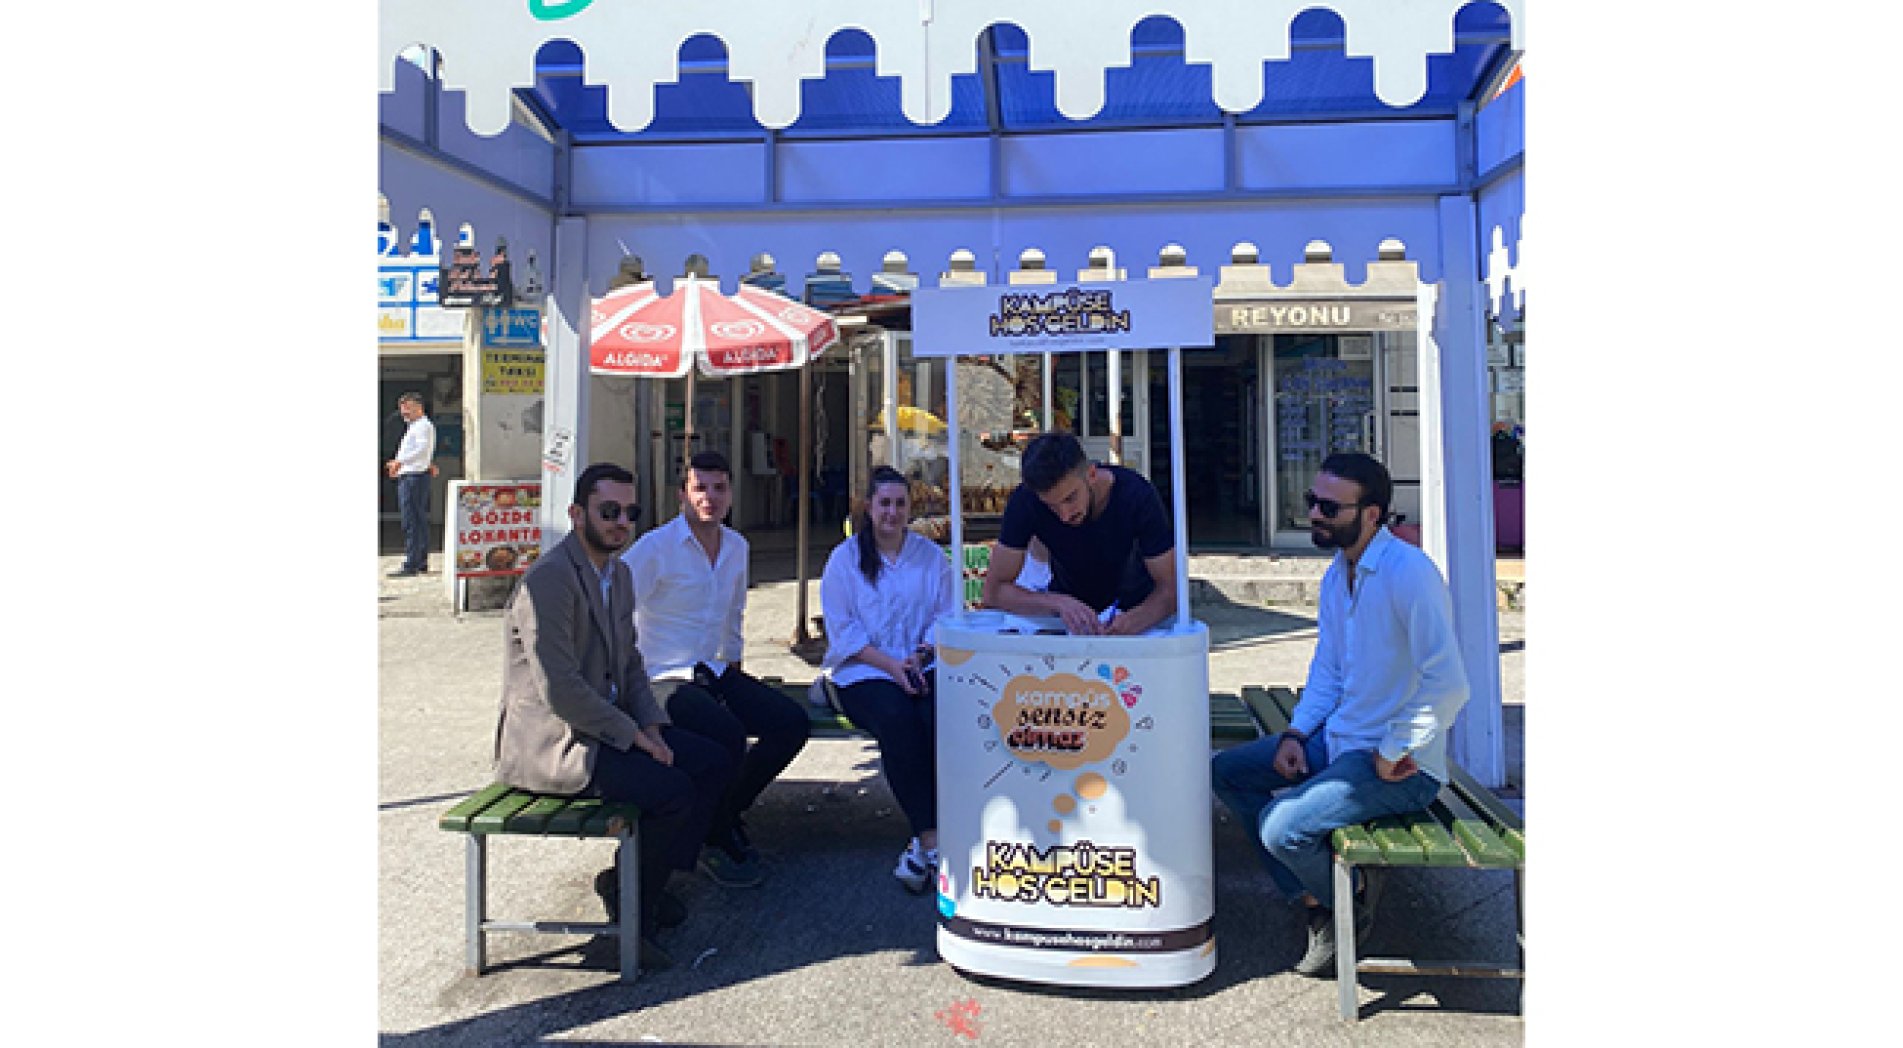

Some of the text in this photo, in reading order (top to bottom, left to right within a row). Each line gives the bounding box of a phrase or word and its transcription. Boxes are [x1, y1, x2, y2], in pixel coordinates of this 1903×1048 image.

[1001, 288, 1113, 313] KAMPÜSE
[1231, 305, 1352, 327] REYONU
[602, 352, 663, 367] ALGIDA
[1016, 703, 1107, 729] sensiz
[987, 840, 1137, 877] KAMPÜSE
